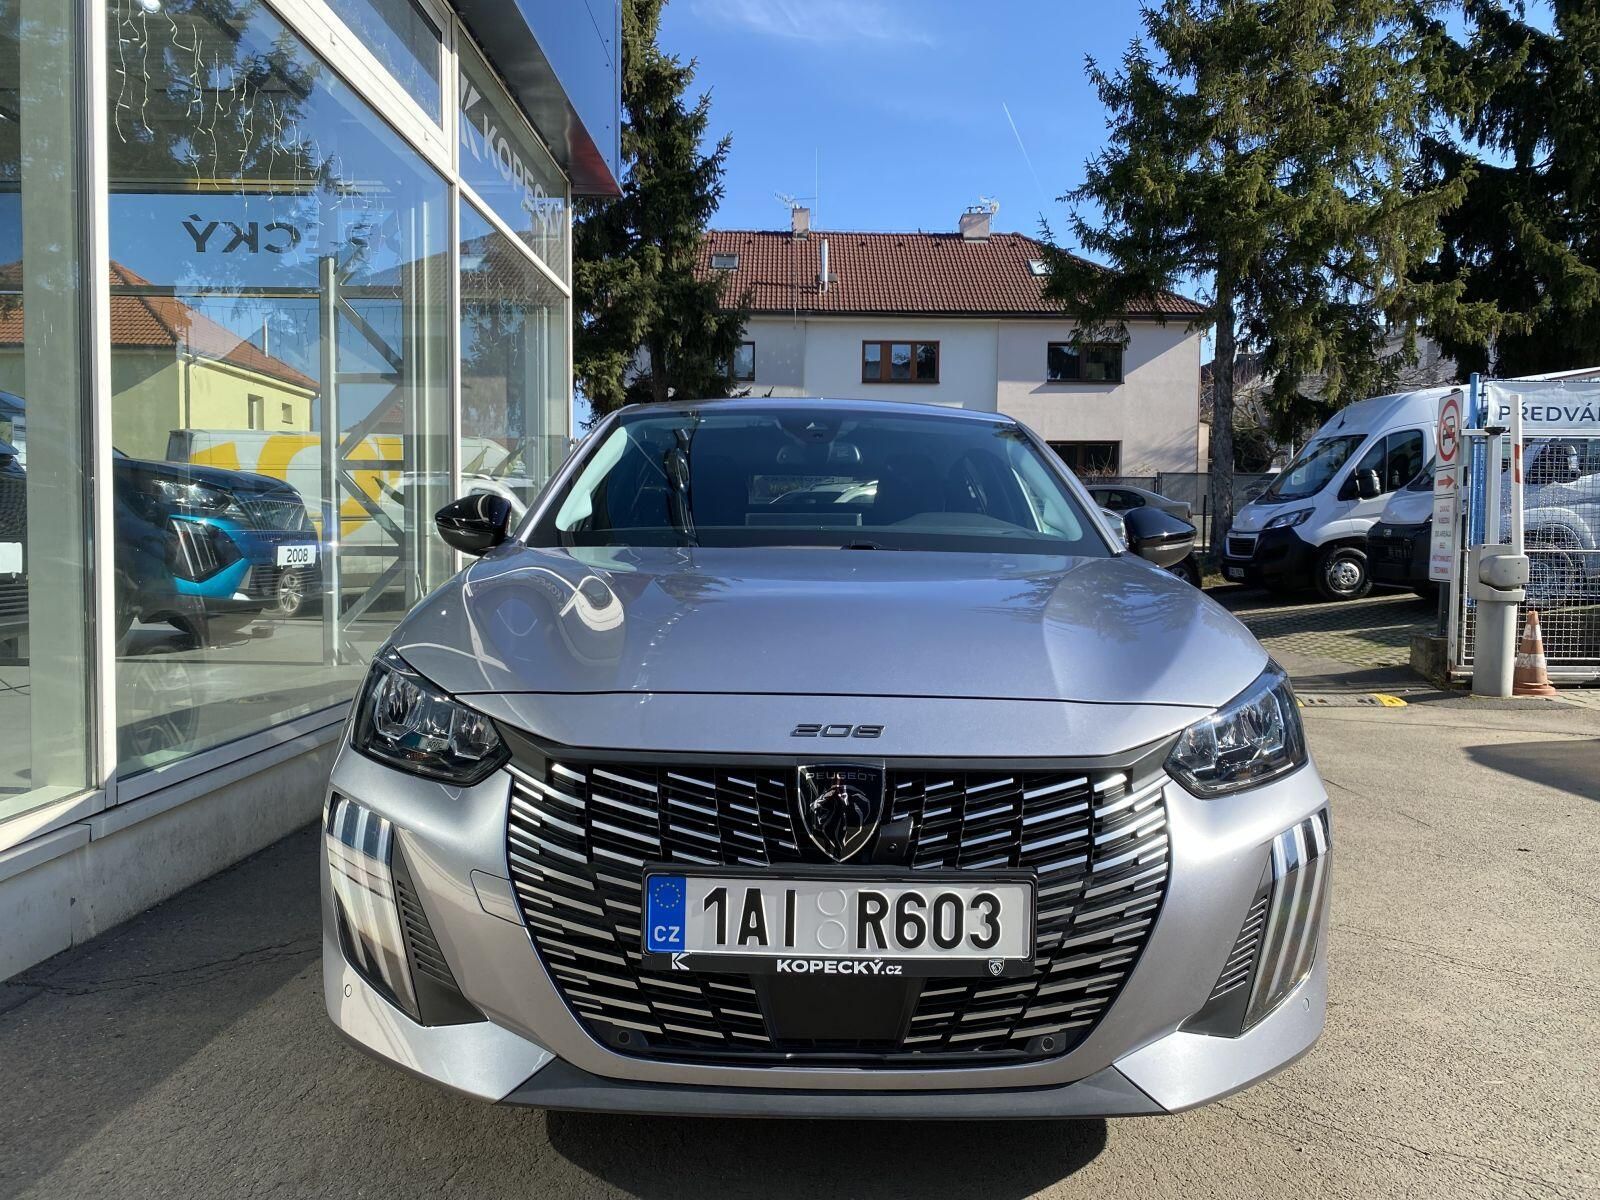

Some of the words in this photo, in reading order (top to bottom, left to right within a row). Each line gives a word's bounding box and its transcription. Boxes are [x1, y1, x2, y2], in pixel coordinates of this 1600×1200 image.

[286, 548, 309, 563] 2008
[790, 724, 885, 738] 208
[805, 771, 877, 781] PEUGEOT
[703, 887, 797, 947] 1AI
[856, 891, 1001, 950] R603
[653, 925, 680, 943] CZ
